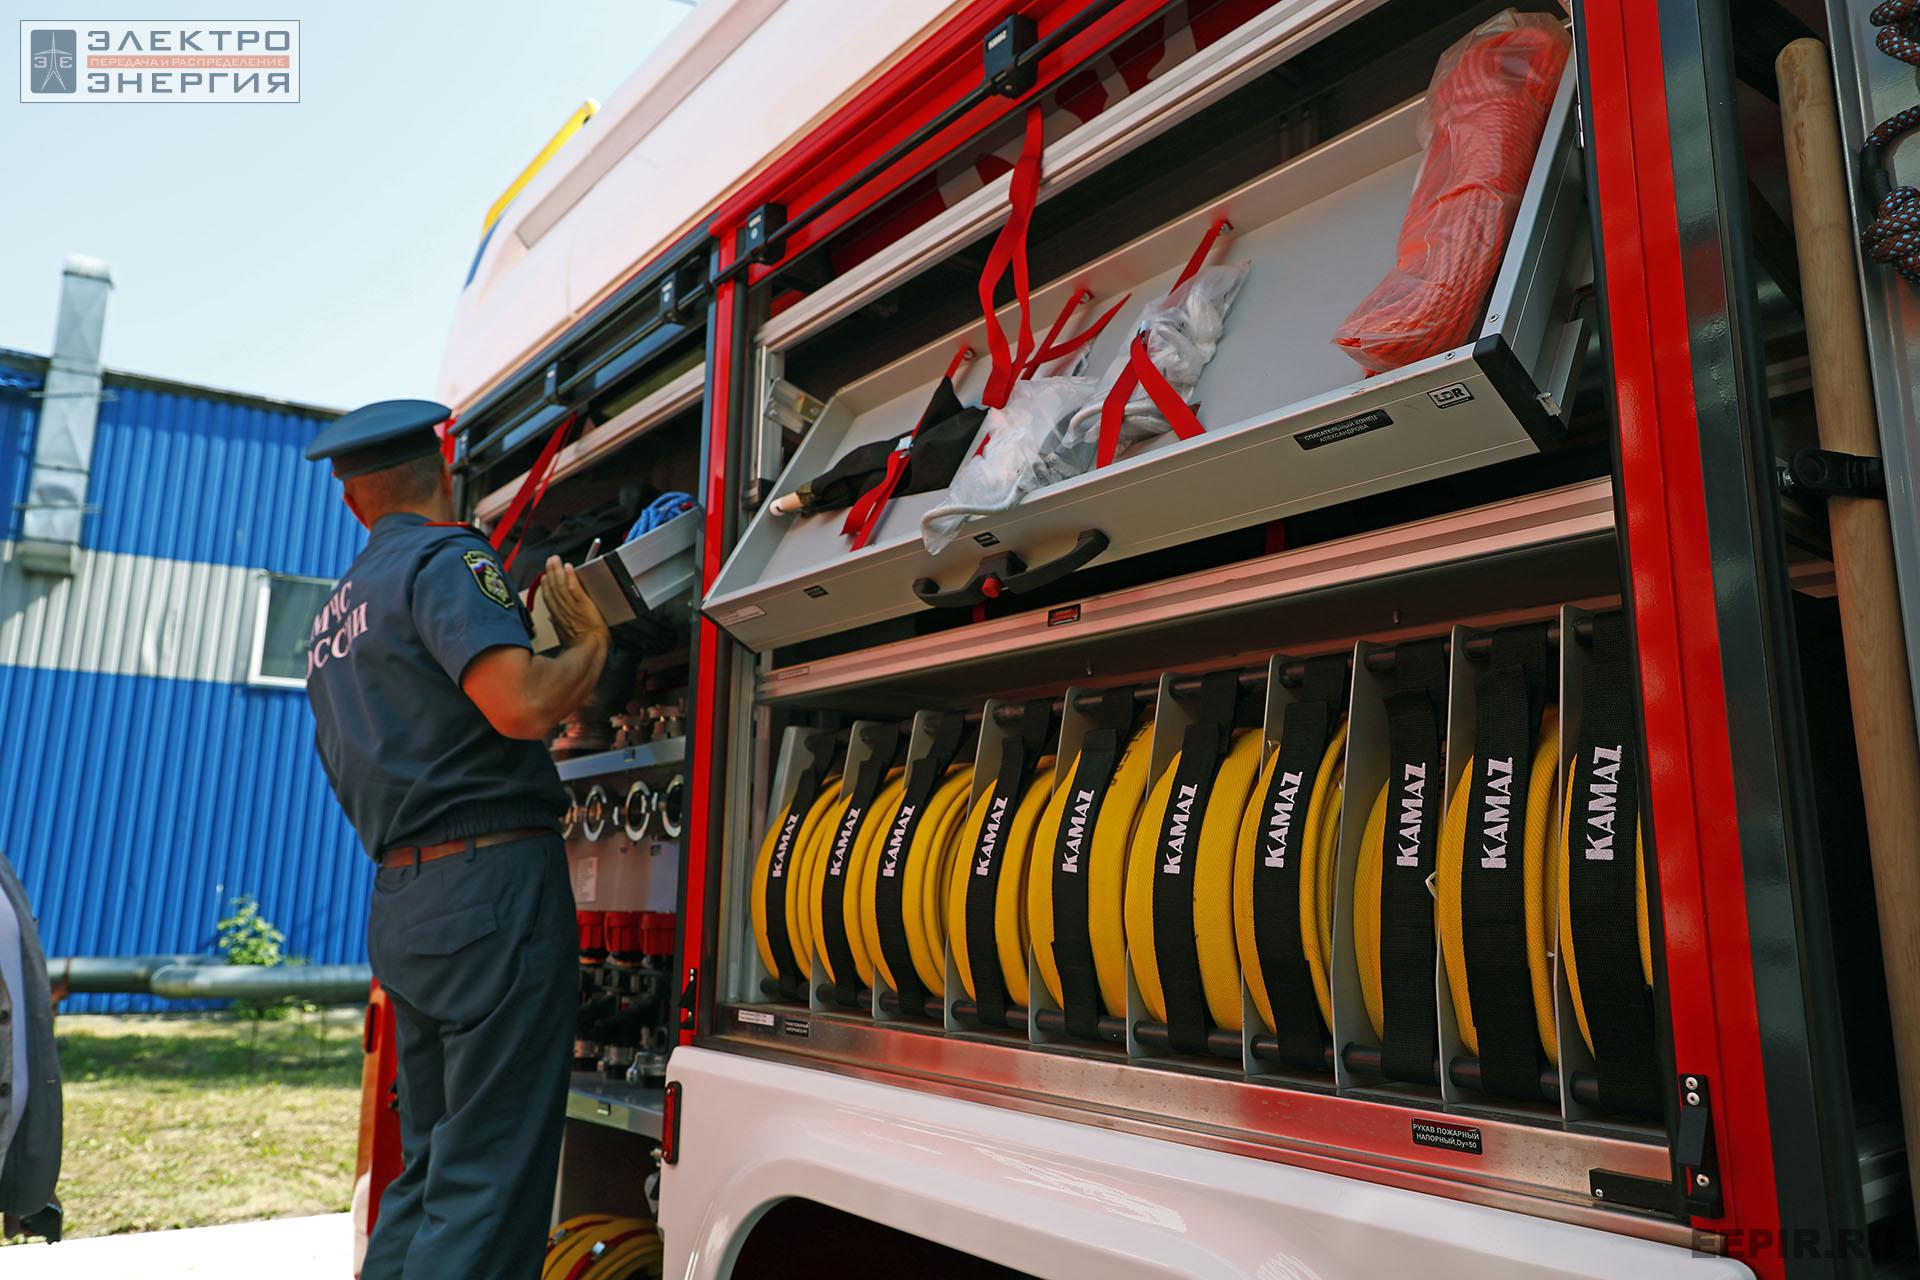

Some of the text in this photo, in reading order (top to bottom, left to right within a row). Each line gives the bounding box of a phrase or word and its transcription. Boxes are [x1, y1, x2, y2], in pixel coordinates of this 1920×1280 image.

[1433, 387, 1465, 403] LDR
[830, 807, 861, 876] KAMAZ
[883, 805, 916, 877] KAMAZ
[976, 797, 1009, 876] KAMAZ
[1062, 789, 1095, 873] KAMAZ
[1164, 784, 1198, 874] KAMAZ
[1265, 771, 1303, 868] KAMAZ
[1397, 762, 1426, 867] KAMAZ
[1481, 757, 1513, 869] KAMAZ
[1585, 745, 1622, 861] KAMAZ
[773, 813, 800, 877] KAMAZ
[1412, 1123, 1480, 1140] РУКАВ ПОЖАРНЫЙ
